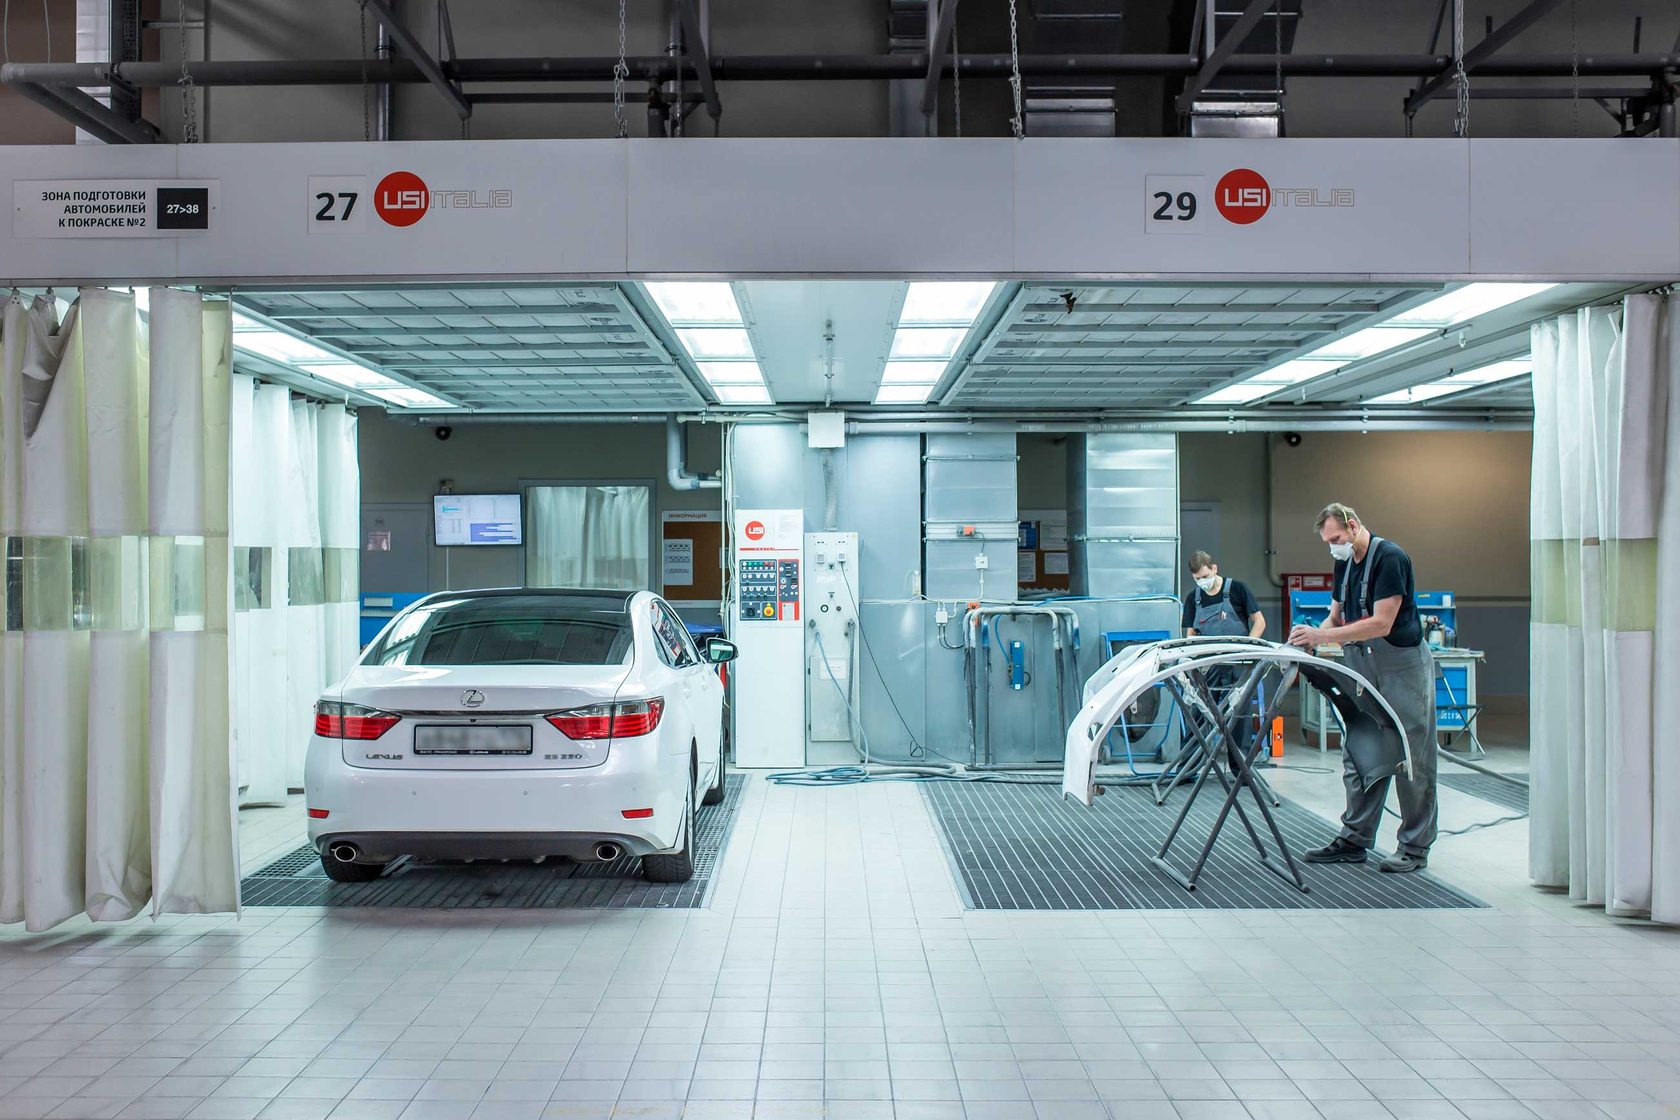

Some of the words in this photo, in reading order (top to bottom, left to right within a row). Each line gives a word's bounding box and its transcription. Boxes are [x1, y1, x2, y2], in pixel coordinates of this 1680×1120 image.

[42, 191, 70, 201] ЗОНА
[73, 191, 146, 201] ПОДГОТОВКИ
[383, 190, 426, 209] USI
[1224, 188, 1267, 207] USI
[64, 202, 146, 214] АВТОМОБИЛЕЙ
[166, 204, 200, 214] 27>38
[315, 192, 358, 221] 27
[1152, 191, 1197, 221] 29
[58, 218, 65, 227] К
[68, 218, 125, 227] ПОКРАСКЕ
[127, 217, 146, 227] №2
[748, 526, 764, 535] USI
